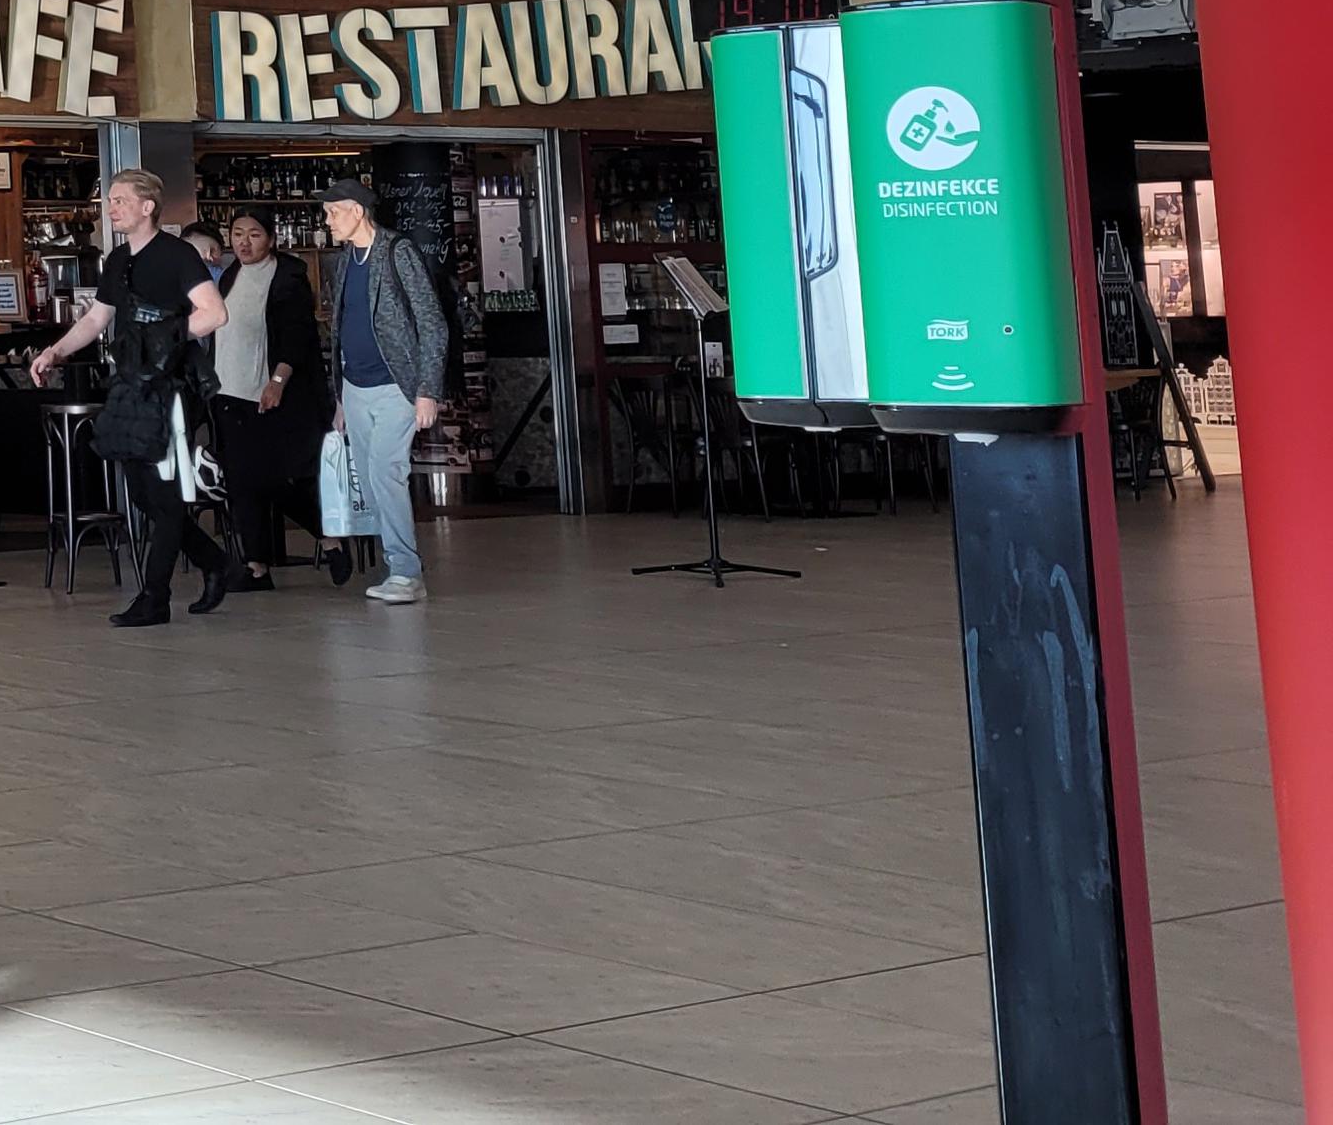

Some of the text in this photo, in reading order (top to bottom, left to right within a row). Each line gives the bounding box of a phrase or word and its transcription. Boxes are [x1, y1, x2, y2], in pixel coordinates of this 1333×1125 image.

[878, 178, 1000, 199] DEZINFEKCE
[882, 199, 999, 218] DISINFECTION
[930, 327, 965, 337] TORK
